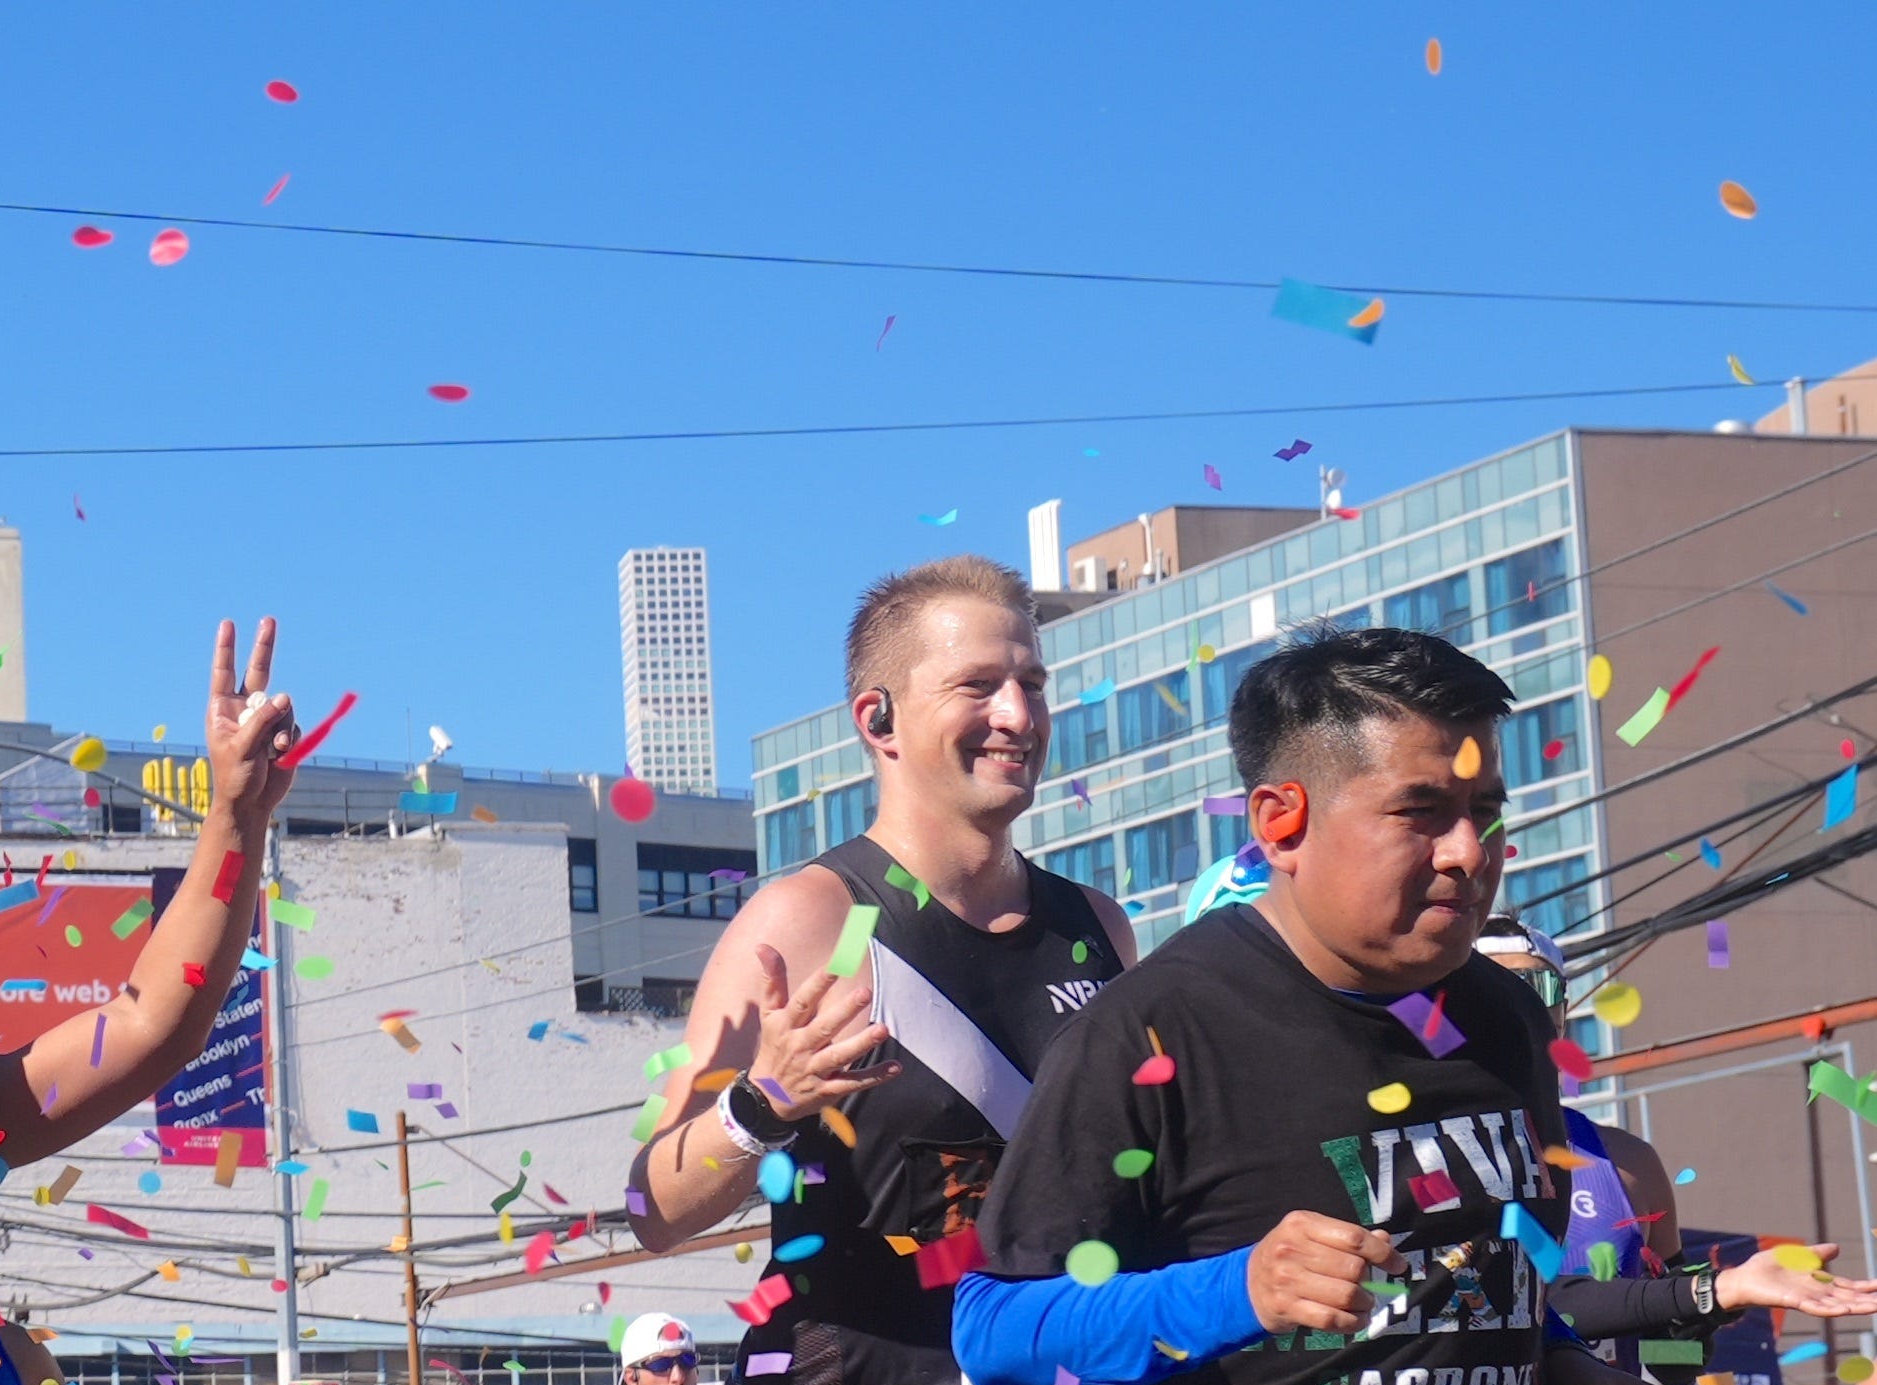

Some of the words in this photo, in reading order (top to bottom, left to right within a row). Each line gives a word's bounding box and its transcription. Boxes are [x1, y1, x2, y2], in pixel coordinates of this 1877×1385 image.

[55, 980, 111, 1004] web
[214, 997, 263, 1028] Staten
[173, 1072, 232, 1107] Queens
[1320, 1109, 1557, 1226] VIVA
